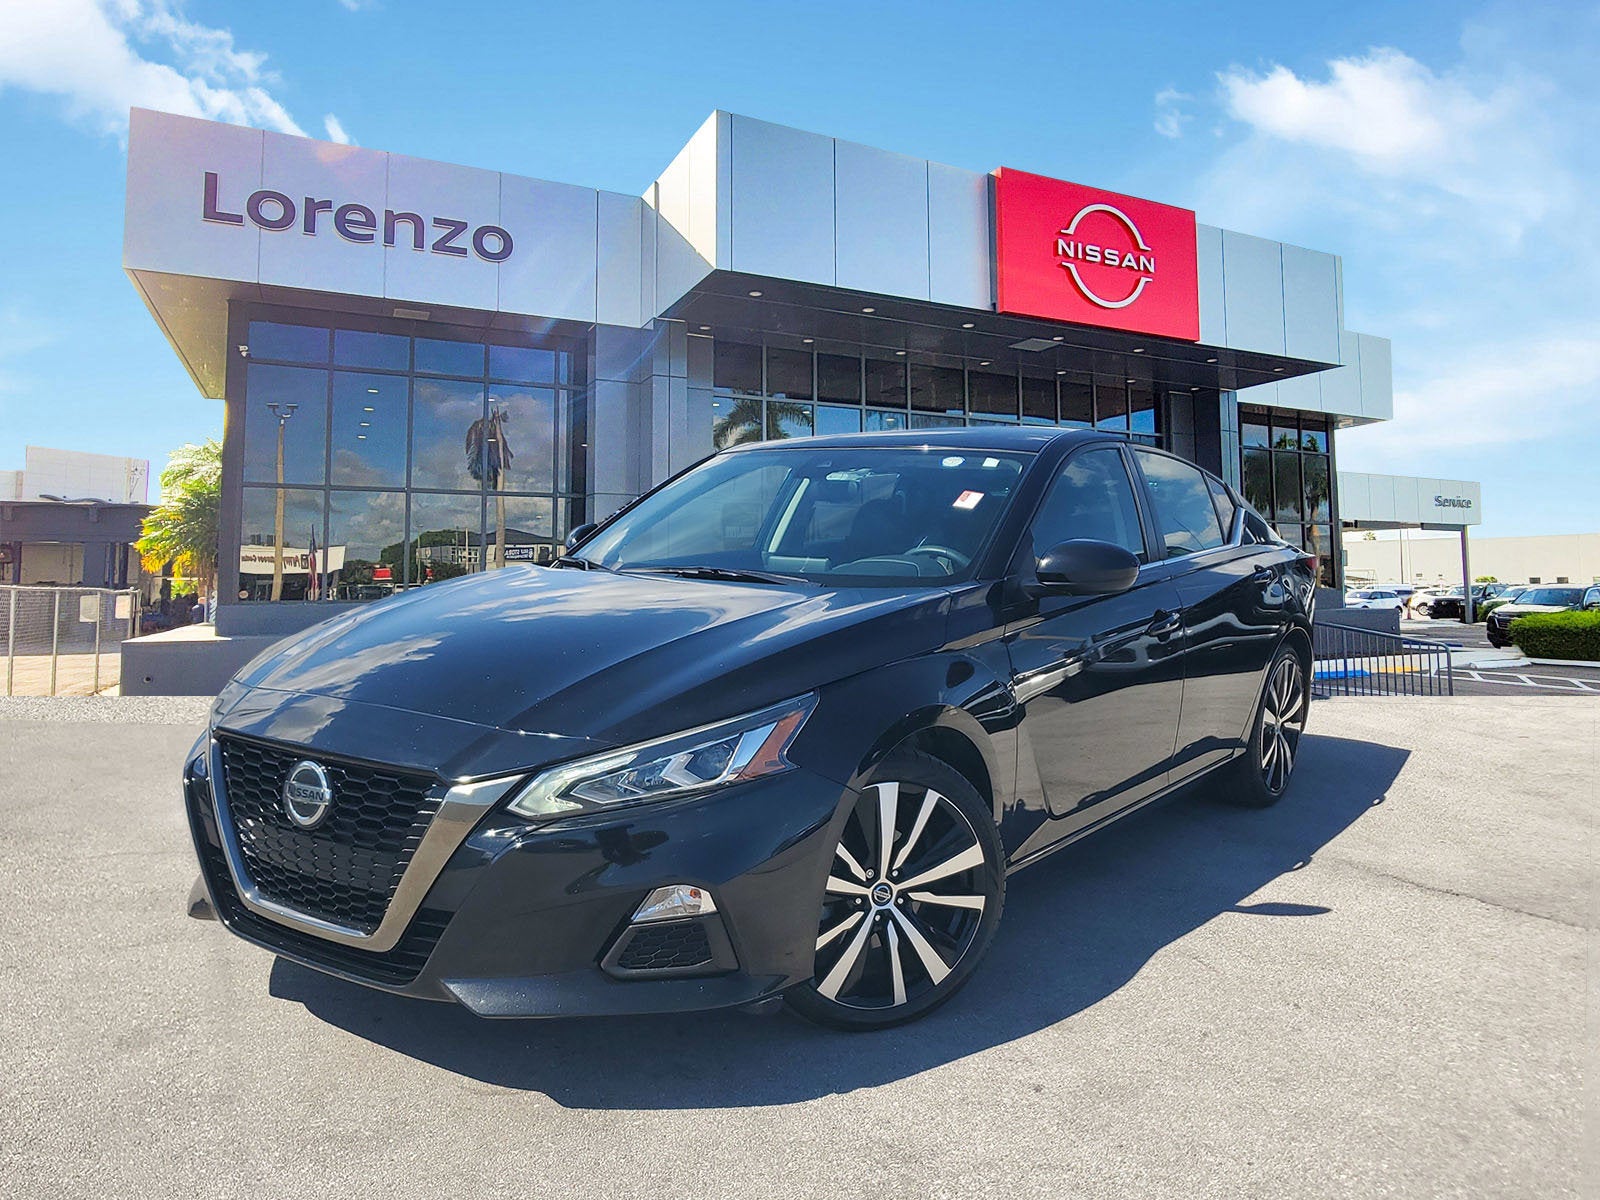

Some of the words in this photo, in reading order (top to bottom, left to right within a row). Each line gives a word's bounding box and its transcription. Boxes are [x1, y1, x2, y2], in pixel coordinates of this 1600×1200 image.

[203, 171, 515, 262] Lorenzo
[1057, 238, 1155, 273] NISSAN
[1434, 495, 1472, 508] Service
